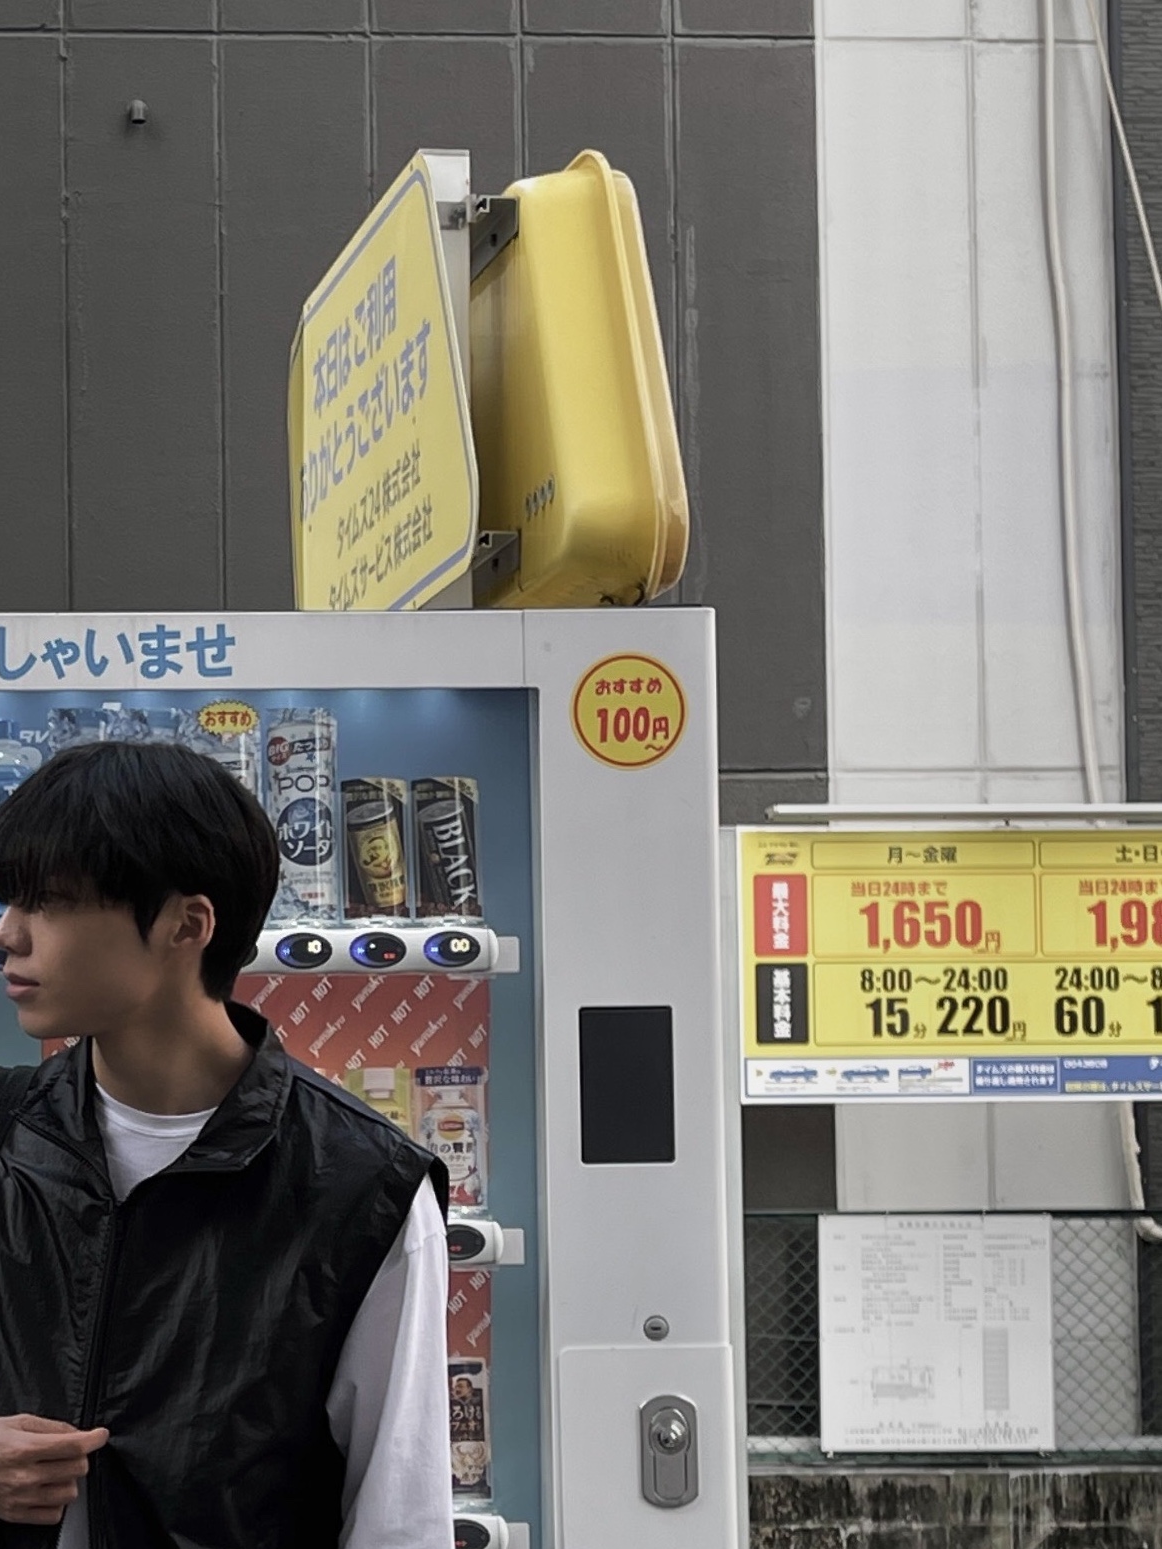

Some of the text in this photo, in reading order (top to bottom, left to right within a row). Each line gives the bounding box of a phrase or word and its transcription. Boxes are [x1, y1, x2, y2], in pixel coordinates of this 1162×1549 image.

[314, 255, 396, 419] 本日はご利用
[595, 678, 663, 695] おすすめ
[205, 711, 252, 726] おすすめ
[278, 774, 330, 795] POP
[432, 814, 478, 910] BLACK
[888, 846, 957, 864] 月～金曜
[851, 881, 947, 897] 当日24時まで
[859, 900, 1001, 954] 1,650円
